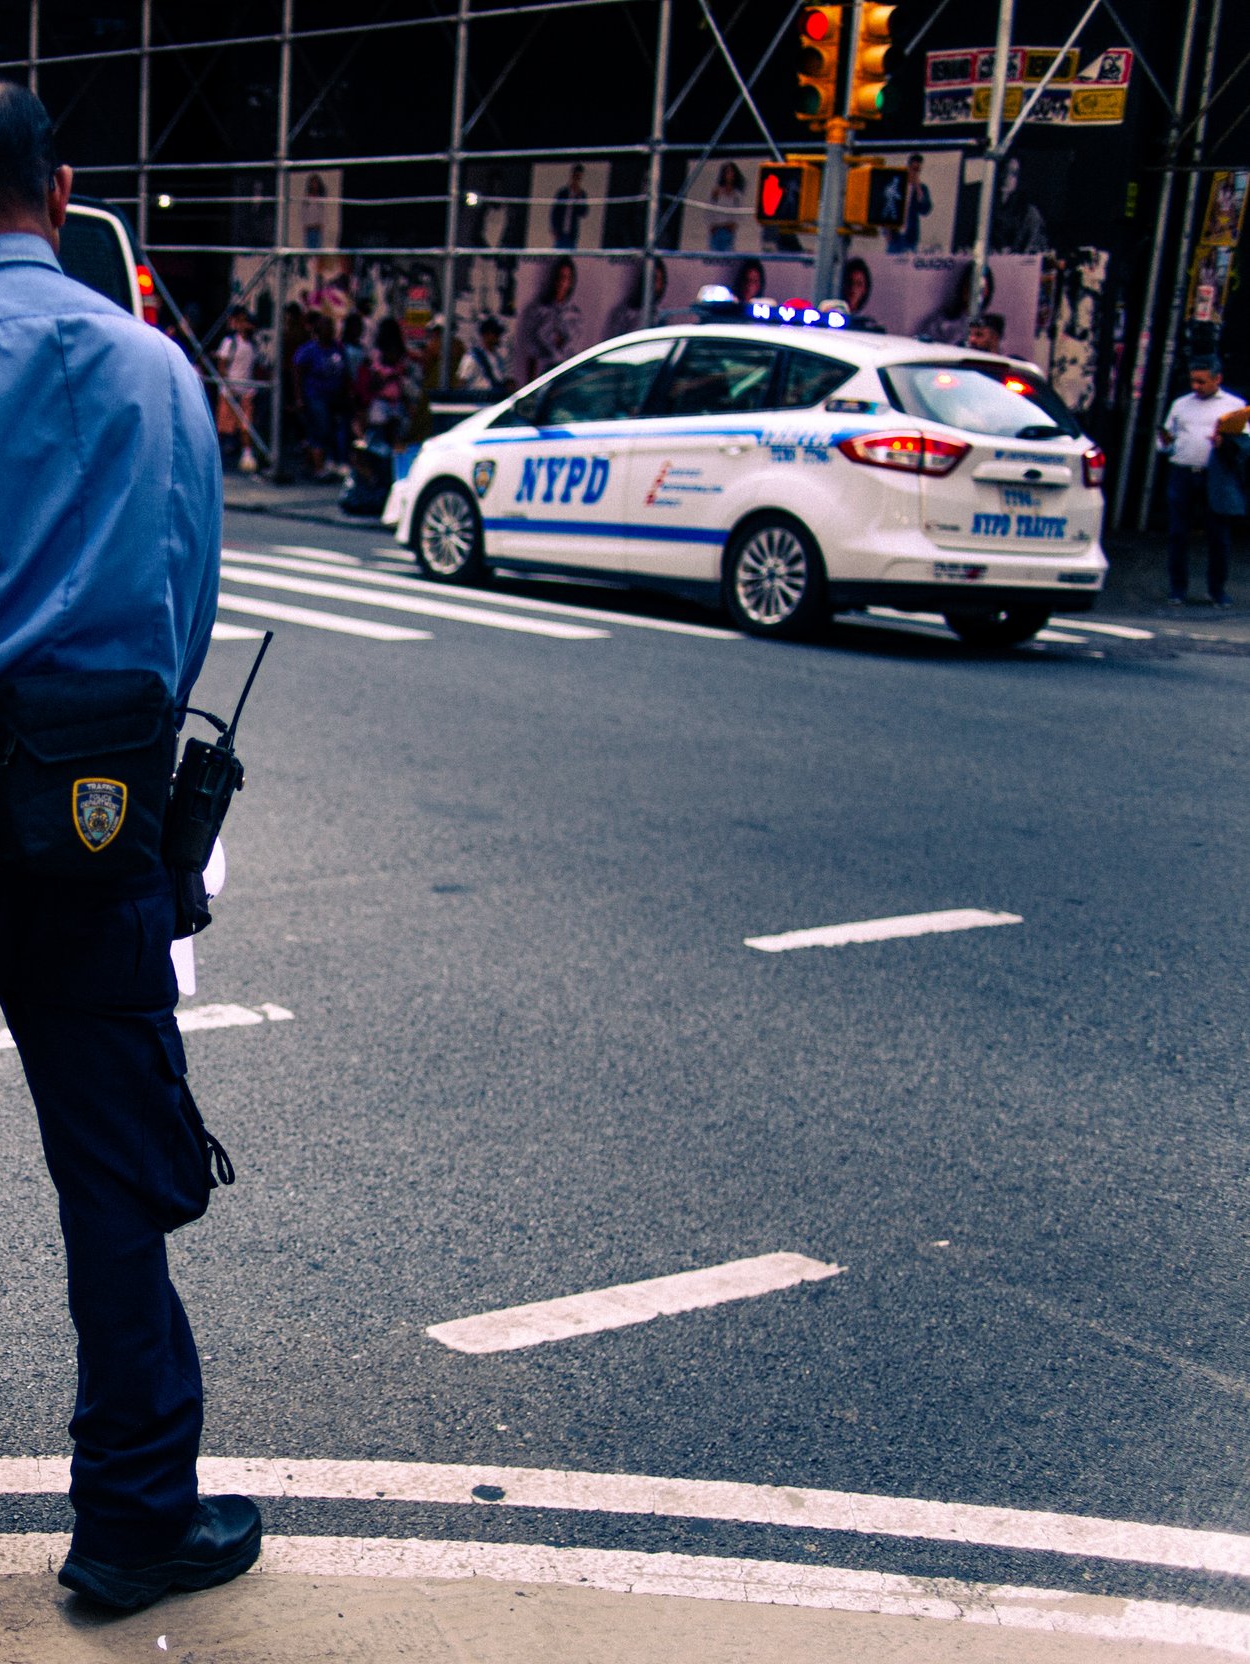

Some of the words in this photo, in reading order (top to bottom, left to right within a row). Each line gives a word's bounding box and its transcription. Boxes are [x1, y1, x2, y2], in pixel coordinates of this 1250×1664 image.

[753, 303, 845, 328] NYPD
[515, 457, 610, 504] NYPD
[971, 513, 1011, 538] NYPD
[1016, 515, 1068, 540] TRAFFIC
[87, 783, 117, 792] TRAFFIC
